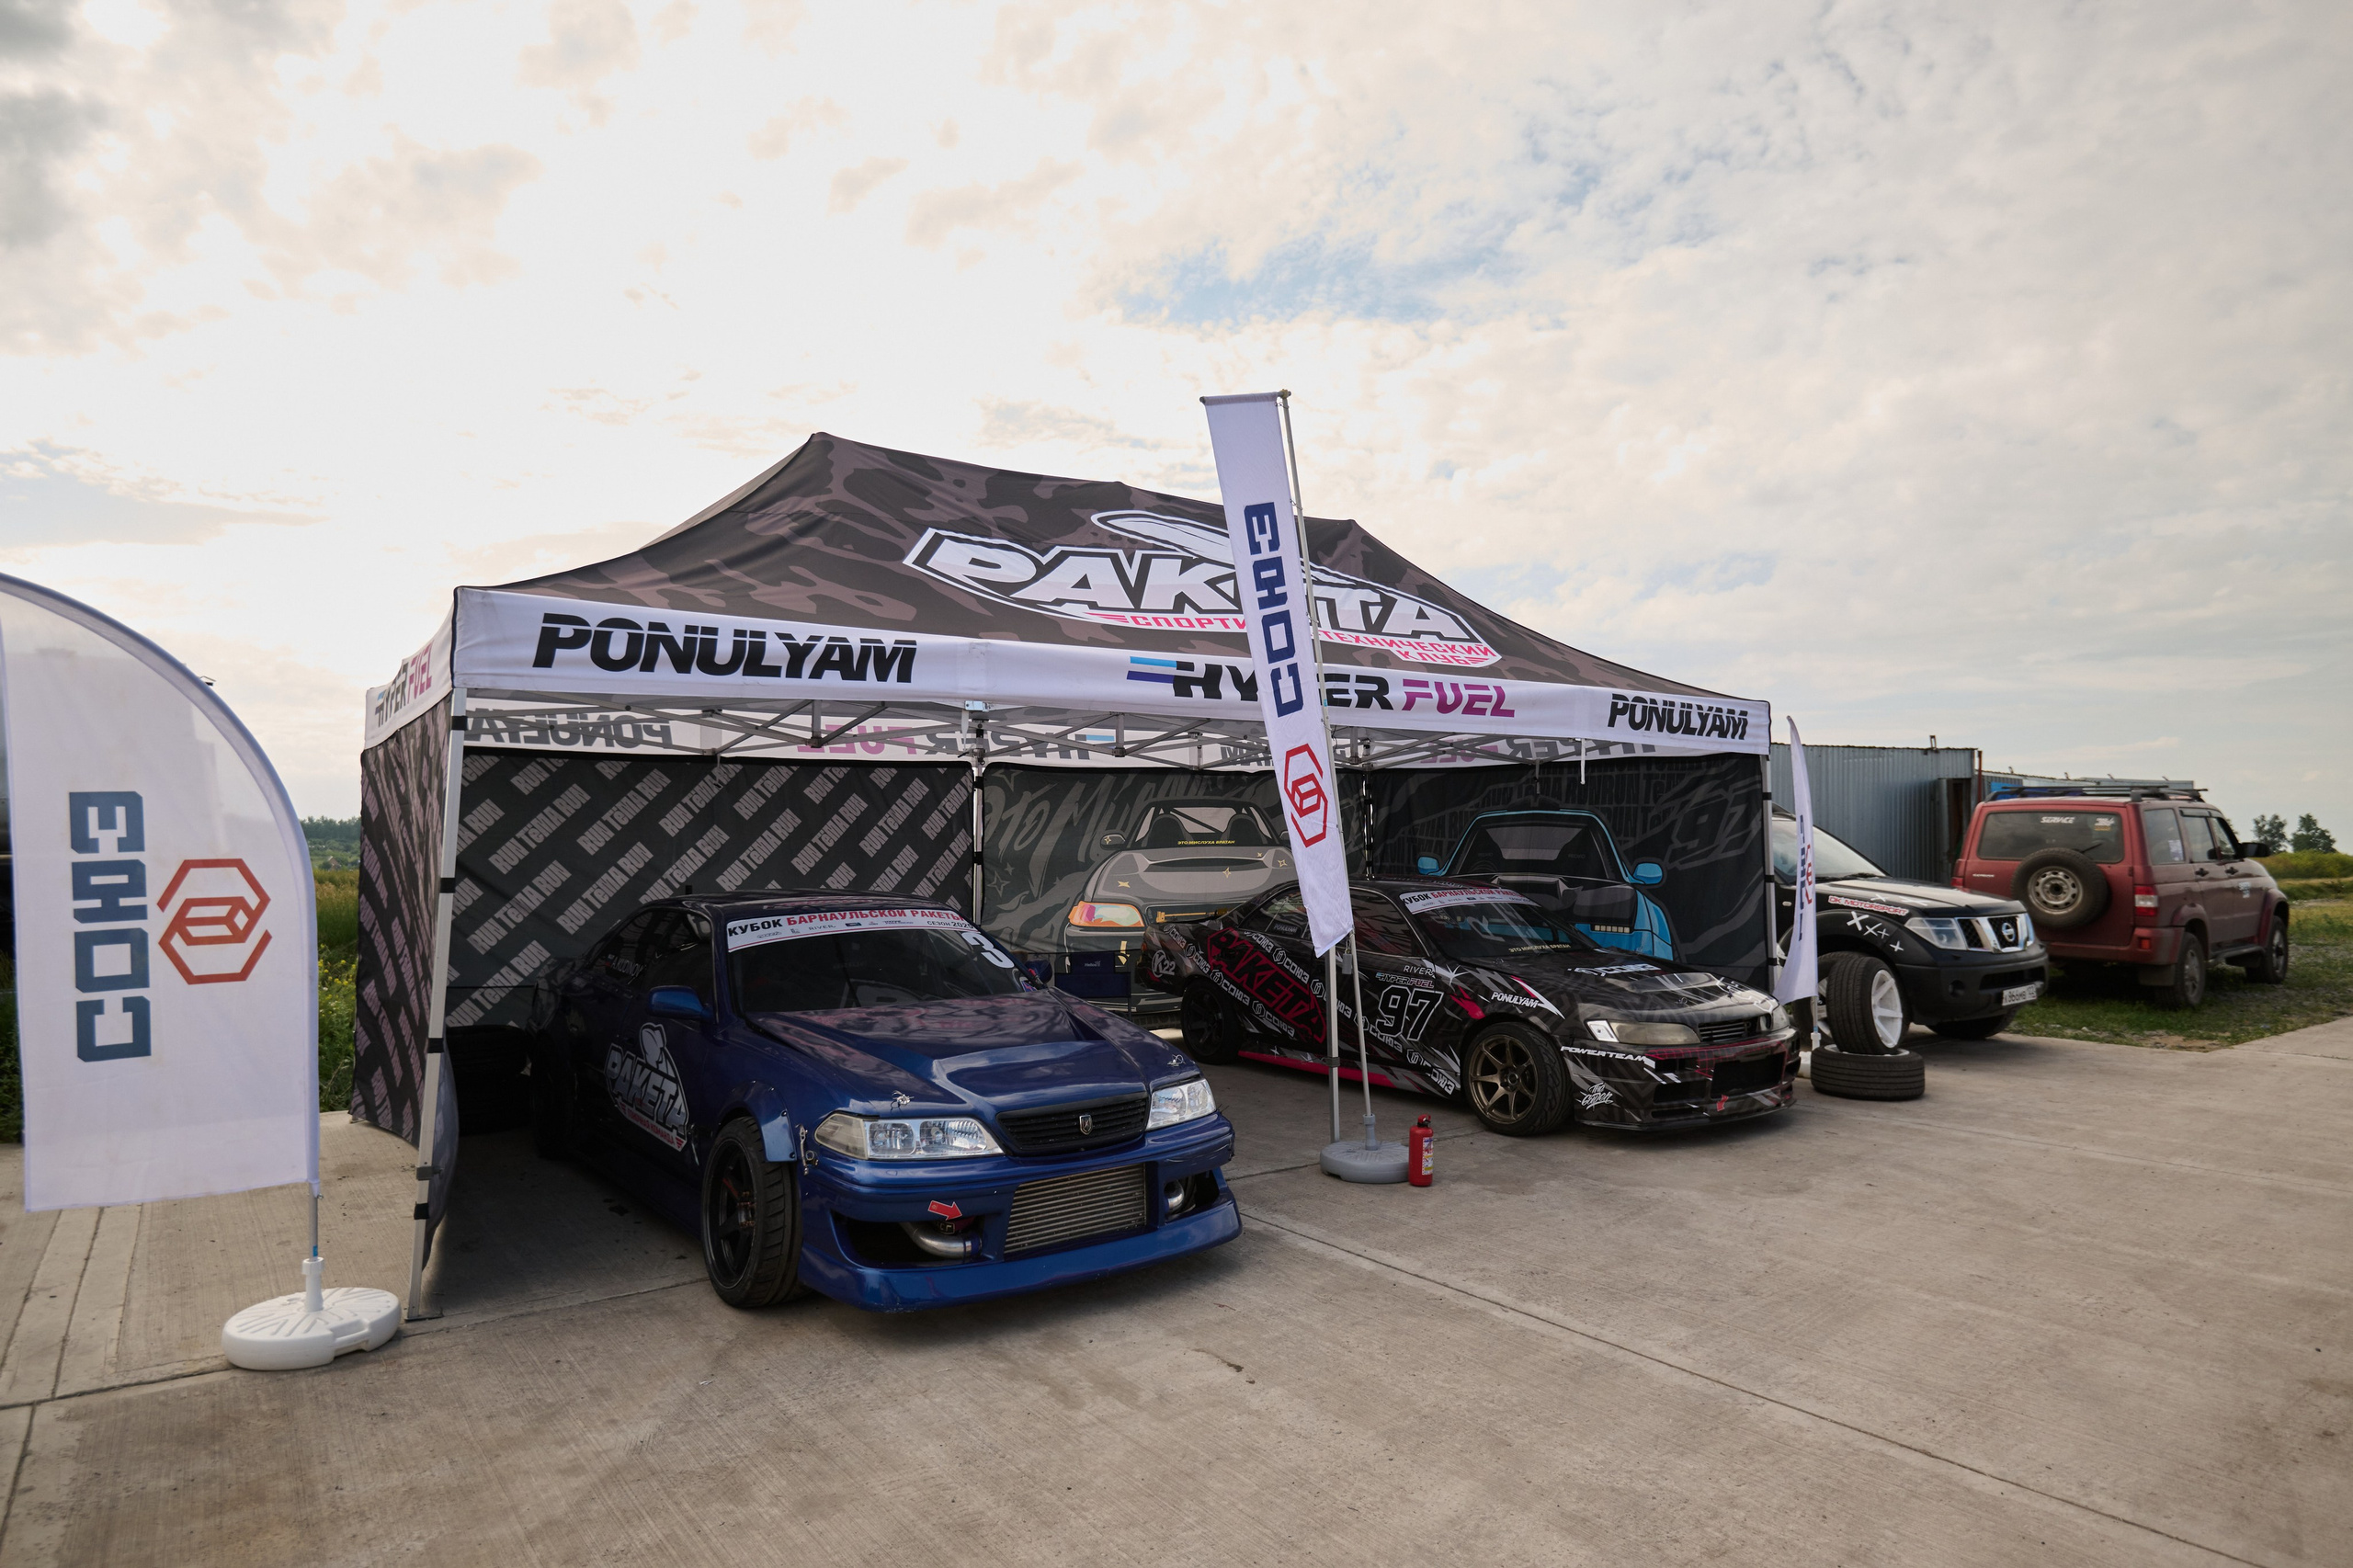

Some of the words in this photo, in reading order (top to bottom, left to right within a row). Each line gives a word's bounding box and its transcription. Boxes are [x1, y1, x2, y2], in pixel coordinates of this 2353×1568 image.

[926, 539, 1471, 639] РАКТА
[1244, 502, 1304, 718] СОЮЗ
[532, 613, 917, 683] PONULYAM
[1398, 650, 1471, 665] КЛУБ
[1173, 661, 1393, 710] HYER
[1402, 678, 1515, 717] FUEL
[1608, 693, 1748, 740] PONULYAM
[69, 790, 152, 1063] СОЮЗ
[727, 918, 783, 937] КУБОК
[787, 909, 907, 926] БАРНАУЛЬСКОЙ
[1222, 980, 1250, 1006] СОЮЗ
[1404, 965, 1432, 975] RIVER
[1376, 984, 1444, 1041] 97
[1491, 991, 1539, 1008] PONULYAM
